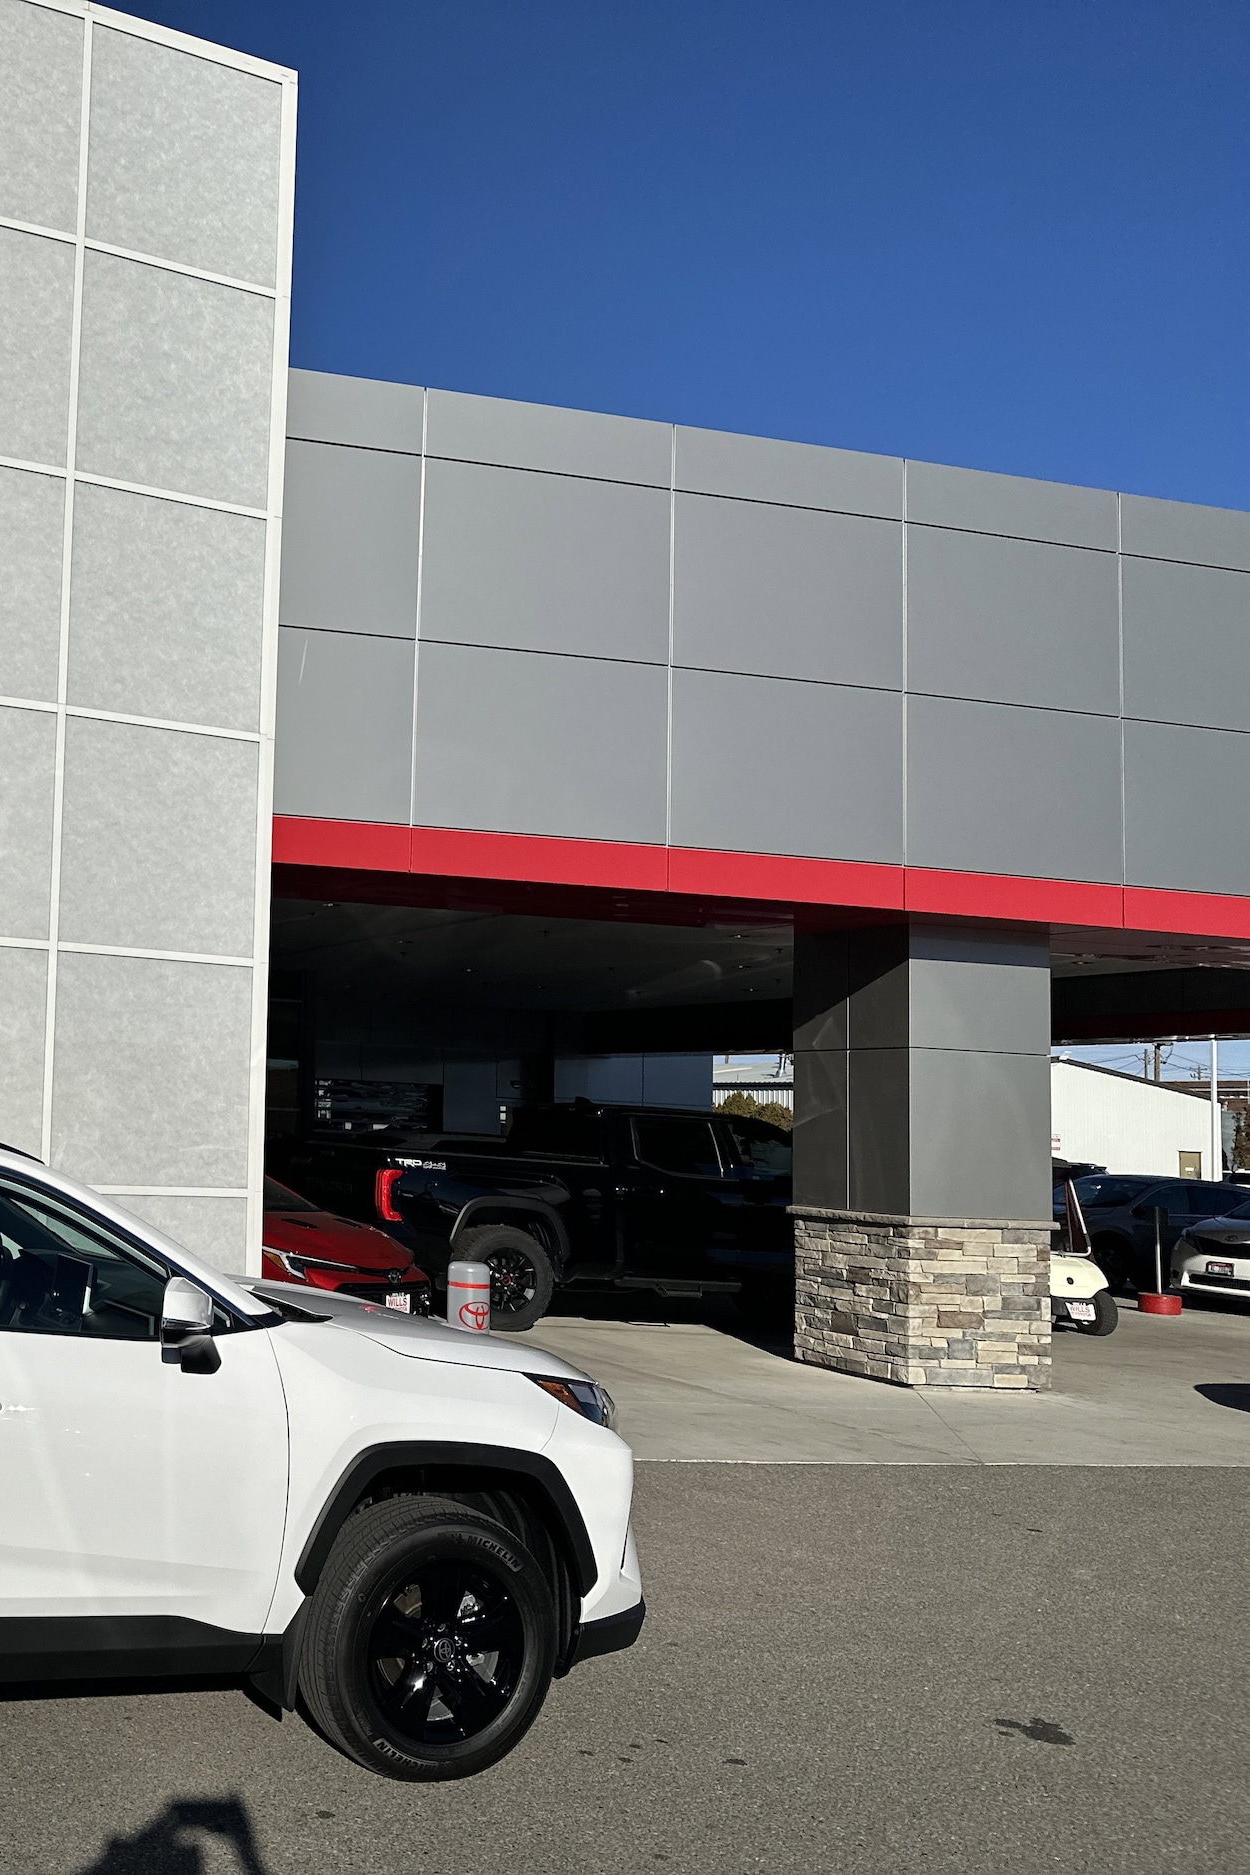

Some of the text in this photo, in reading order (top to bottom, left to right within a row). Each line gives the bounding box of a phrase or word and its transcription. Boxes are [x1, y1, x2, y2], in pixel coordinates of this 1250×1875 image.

[395, 1157, 423, 1169] TRD
[387, 1297, 408, 1307] WILLS
[466, 1534, 521, 1570] MICHELIN
[375, 1740, 437, 1769] MICHELIN
